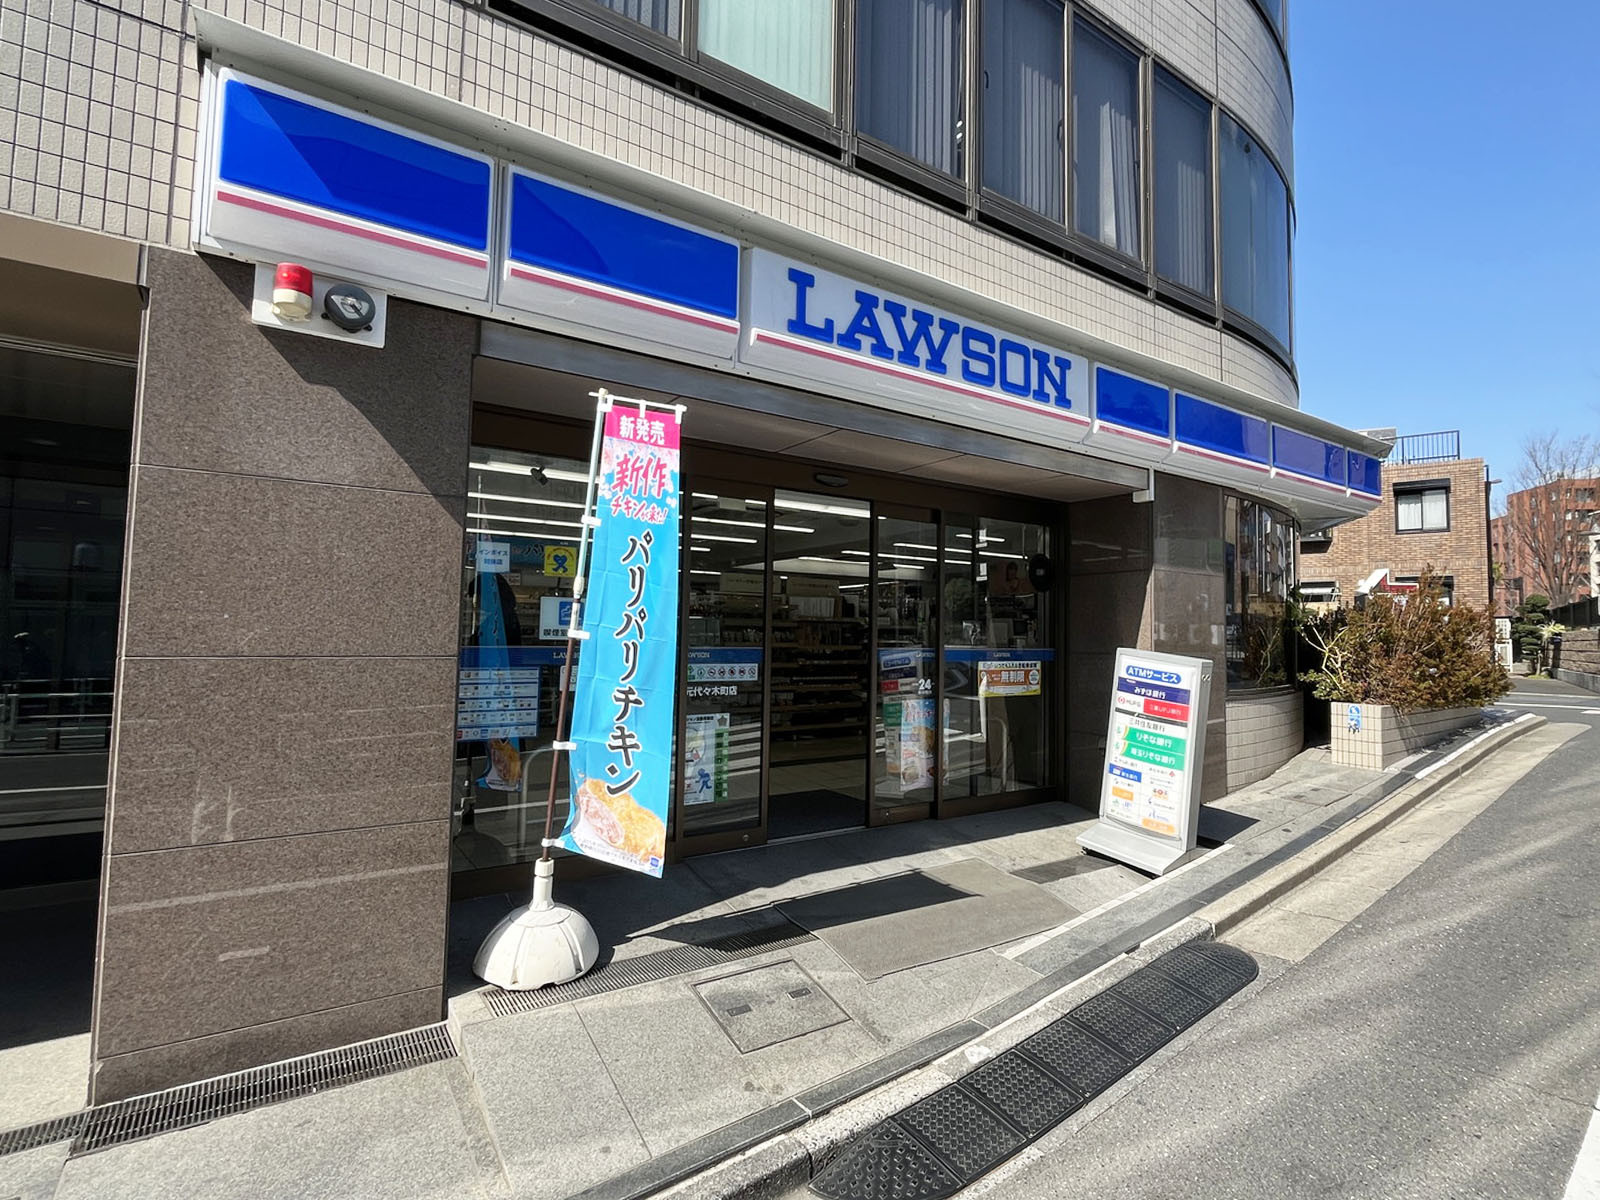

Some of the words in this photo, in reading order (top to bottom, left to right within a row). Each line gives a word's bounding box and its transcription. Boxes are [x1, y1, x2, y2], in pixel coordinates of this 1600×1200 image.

[788, 268, 1072, 409] LAWSON
[619, 415, 665, 445] 新発売
[612, 454, 667, 497] 新作
[606, 529, 652, 796] パリパリチキン
[1127, 666, 1178, 683] ATMサービス
[687, 686, 737, 697] 元代々木町店
[1134, 687, 1166, 699] みずほ銀行
[1130, 717, 1165, 732] 三井住友銀行
[1136, 732, 1172, 748] りそな銀行
